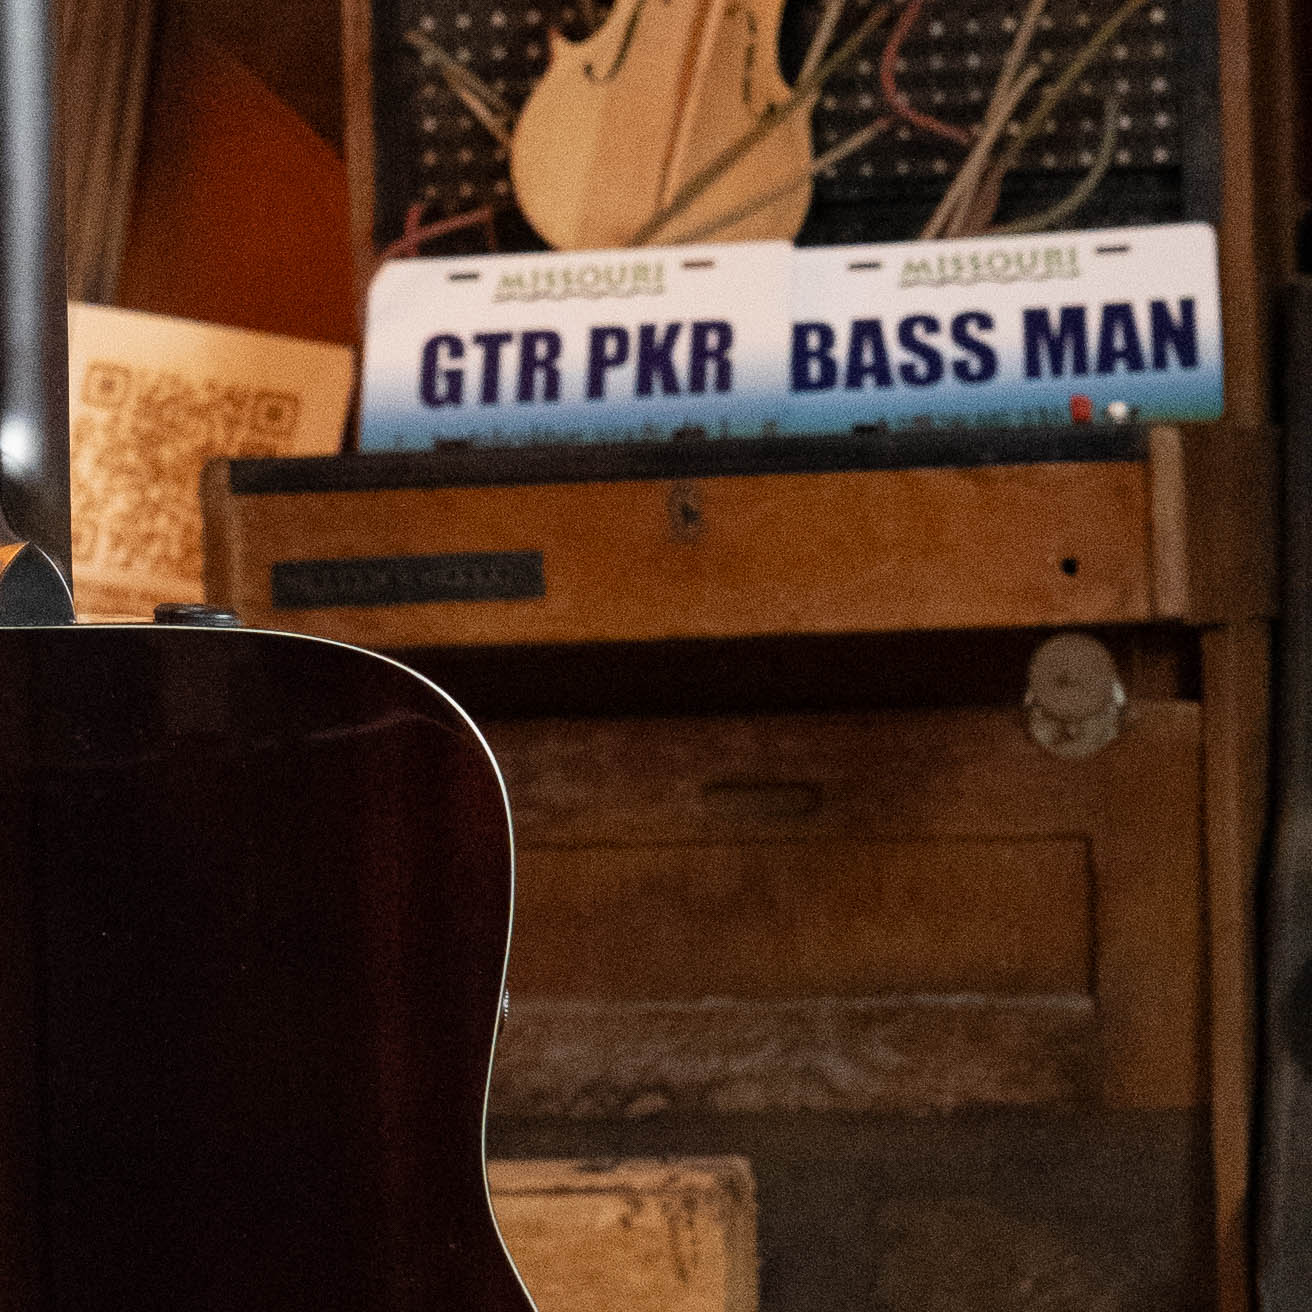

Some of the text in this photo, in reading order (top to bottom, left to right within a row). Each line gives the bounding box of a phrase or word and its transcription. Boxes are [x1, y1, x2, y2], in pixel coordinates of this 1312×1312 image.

[496, 261, 665, 296] MISSOURI
[901, 245, 1082, 284] MISSOURI
[418, 319, 735, 409] GTR PKR
[789, 296, 1200, 392] BASS MAN
